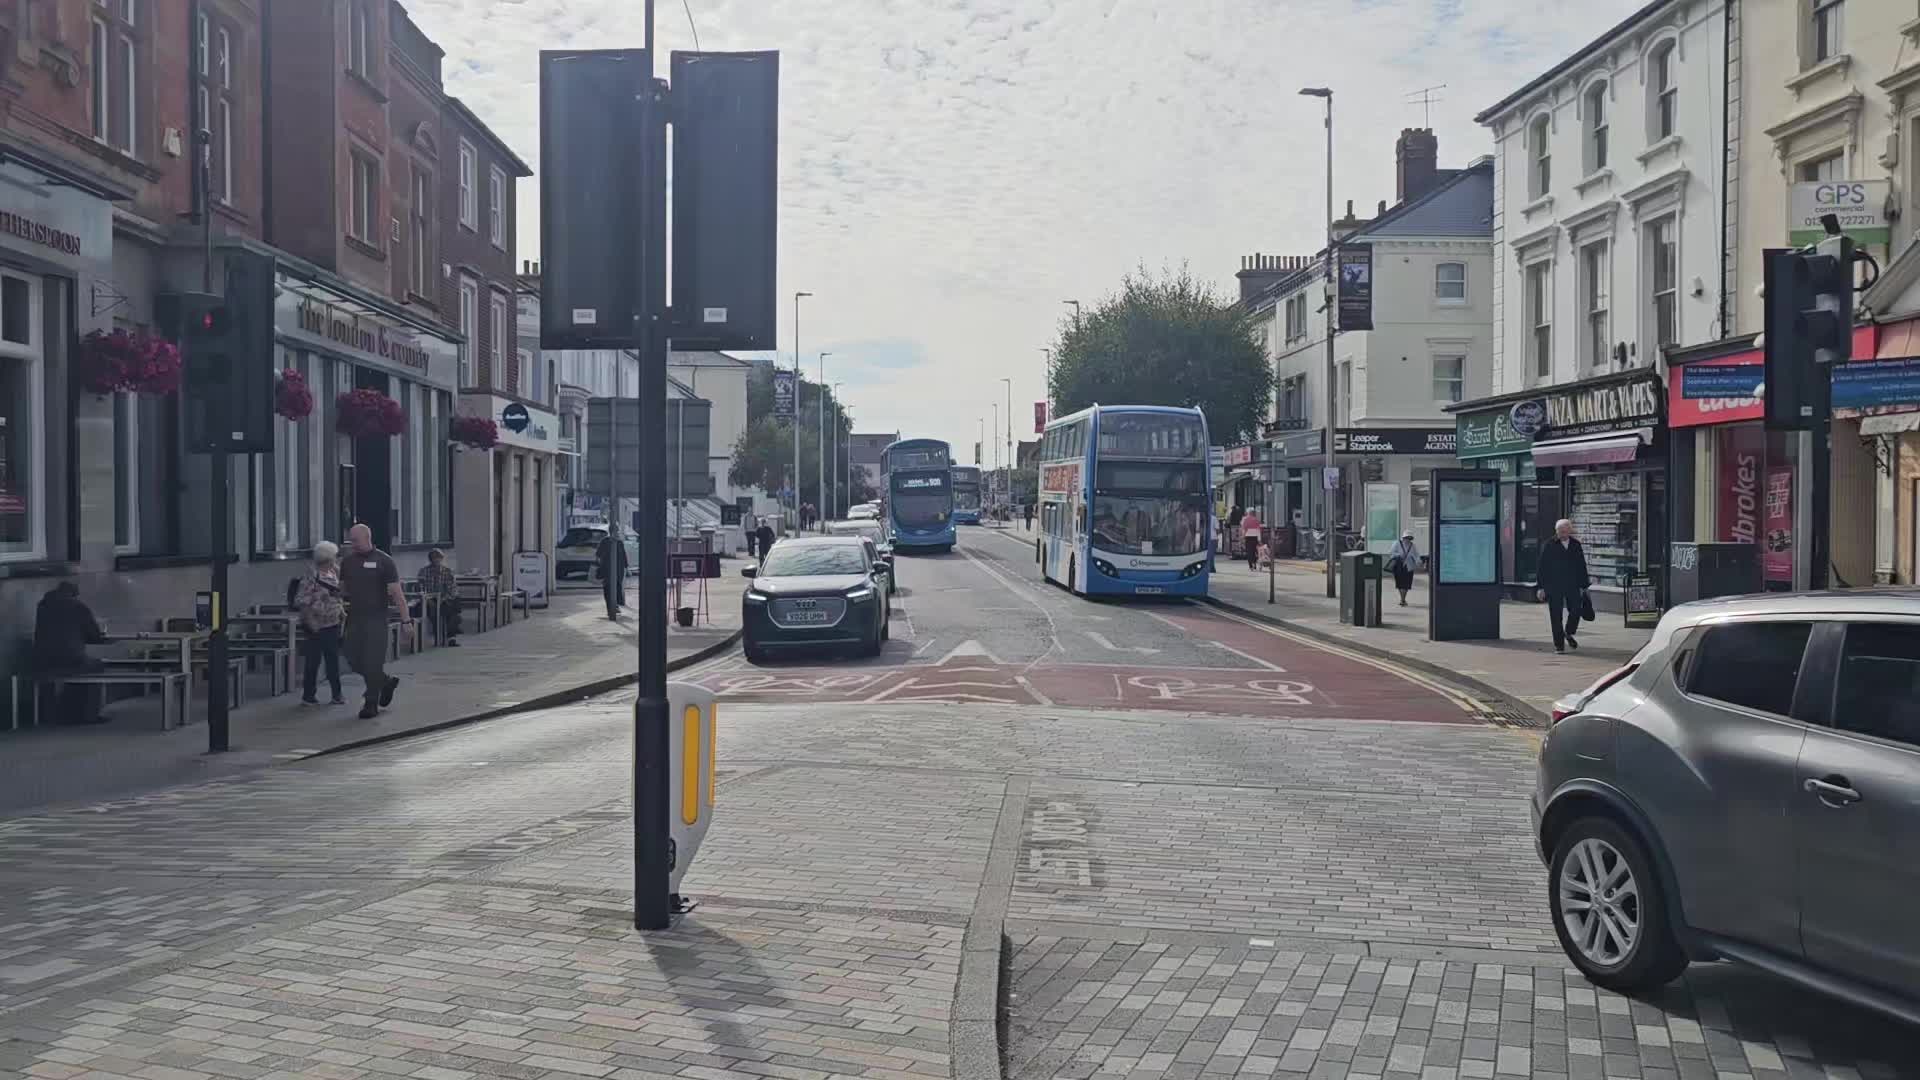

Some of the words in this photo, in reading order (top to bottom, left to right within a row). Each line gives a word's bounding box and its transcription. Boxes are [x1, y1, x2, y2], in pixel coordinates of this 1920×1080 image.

[1815, 184, 1864, 204] GPS
[1815, 205, 1865, 213] commercial
[296, 294, 321, 334] the
[325, 304, 376, 354] london
[378, 327, 390, 358] &
[391, 342, 430, 377] county
[1546, 396, 1574, 427] WAZA
[1577, 388, 1609, 423] MART
[1609, 389, 1618, 419] &
[1617, 380, 1656, 418] VAPES
[1350, 434, 1380, 442] Leaper
[1350, 442, 1393, 451] Stanbrook
